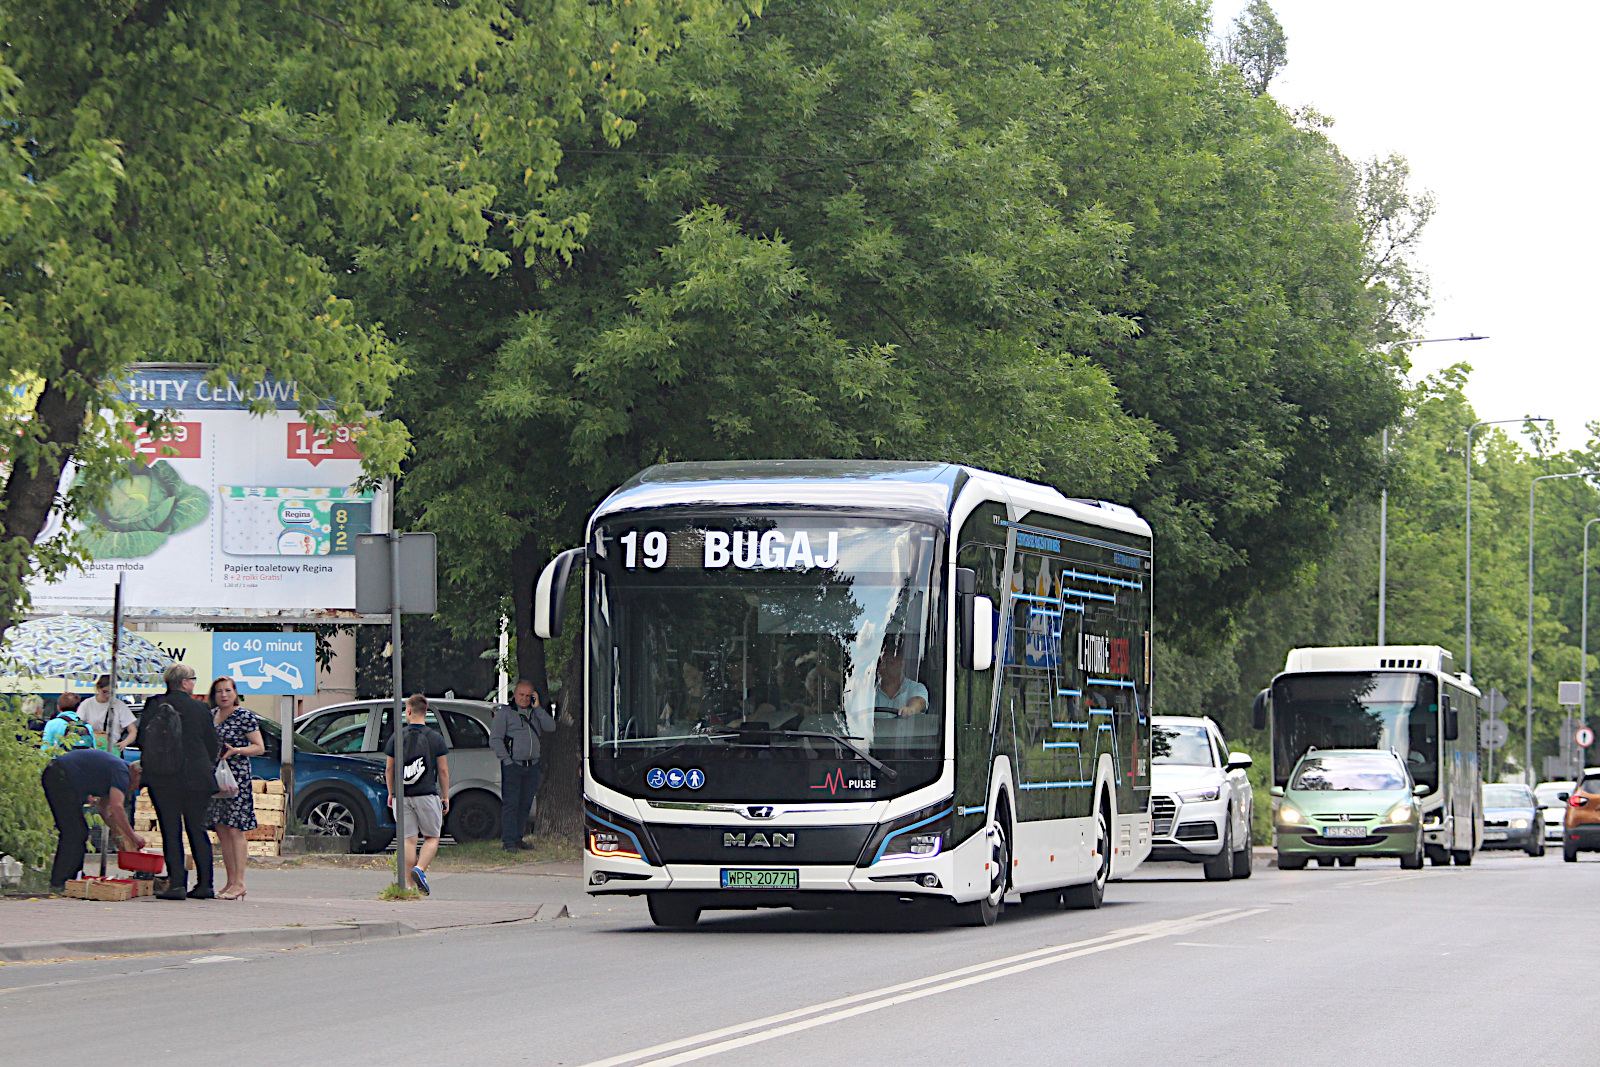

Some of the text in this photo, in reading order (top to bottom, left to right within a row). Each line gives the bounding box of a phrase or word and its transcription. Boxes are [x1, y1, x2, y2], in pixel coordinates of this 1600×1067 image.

[129, 379, 189, 401] HITY
[284, 510, 311, 519] Regina
[335, 509, 348, 524] 8
[335, 531, 348, 545] 2
[620, 530, 839, 569] 19 BUGAJ
[116, 562, 144, 571] młoda
[224, 563, 333, 574] Papier toaletowy Regina
[222, 638, 303, 652] do 40 minut
[403, 756, 426, 780] NIKE
[848, 779, 877, 789] PULSE
[723, 832, 795, 848] MAN
[728, 871, 796, 885] WPR 2077H
